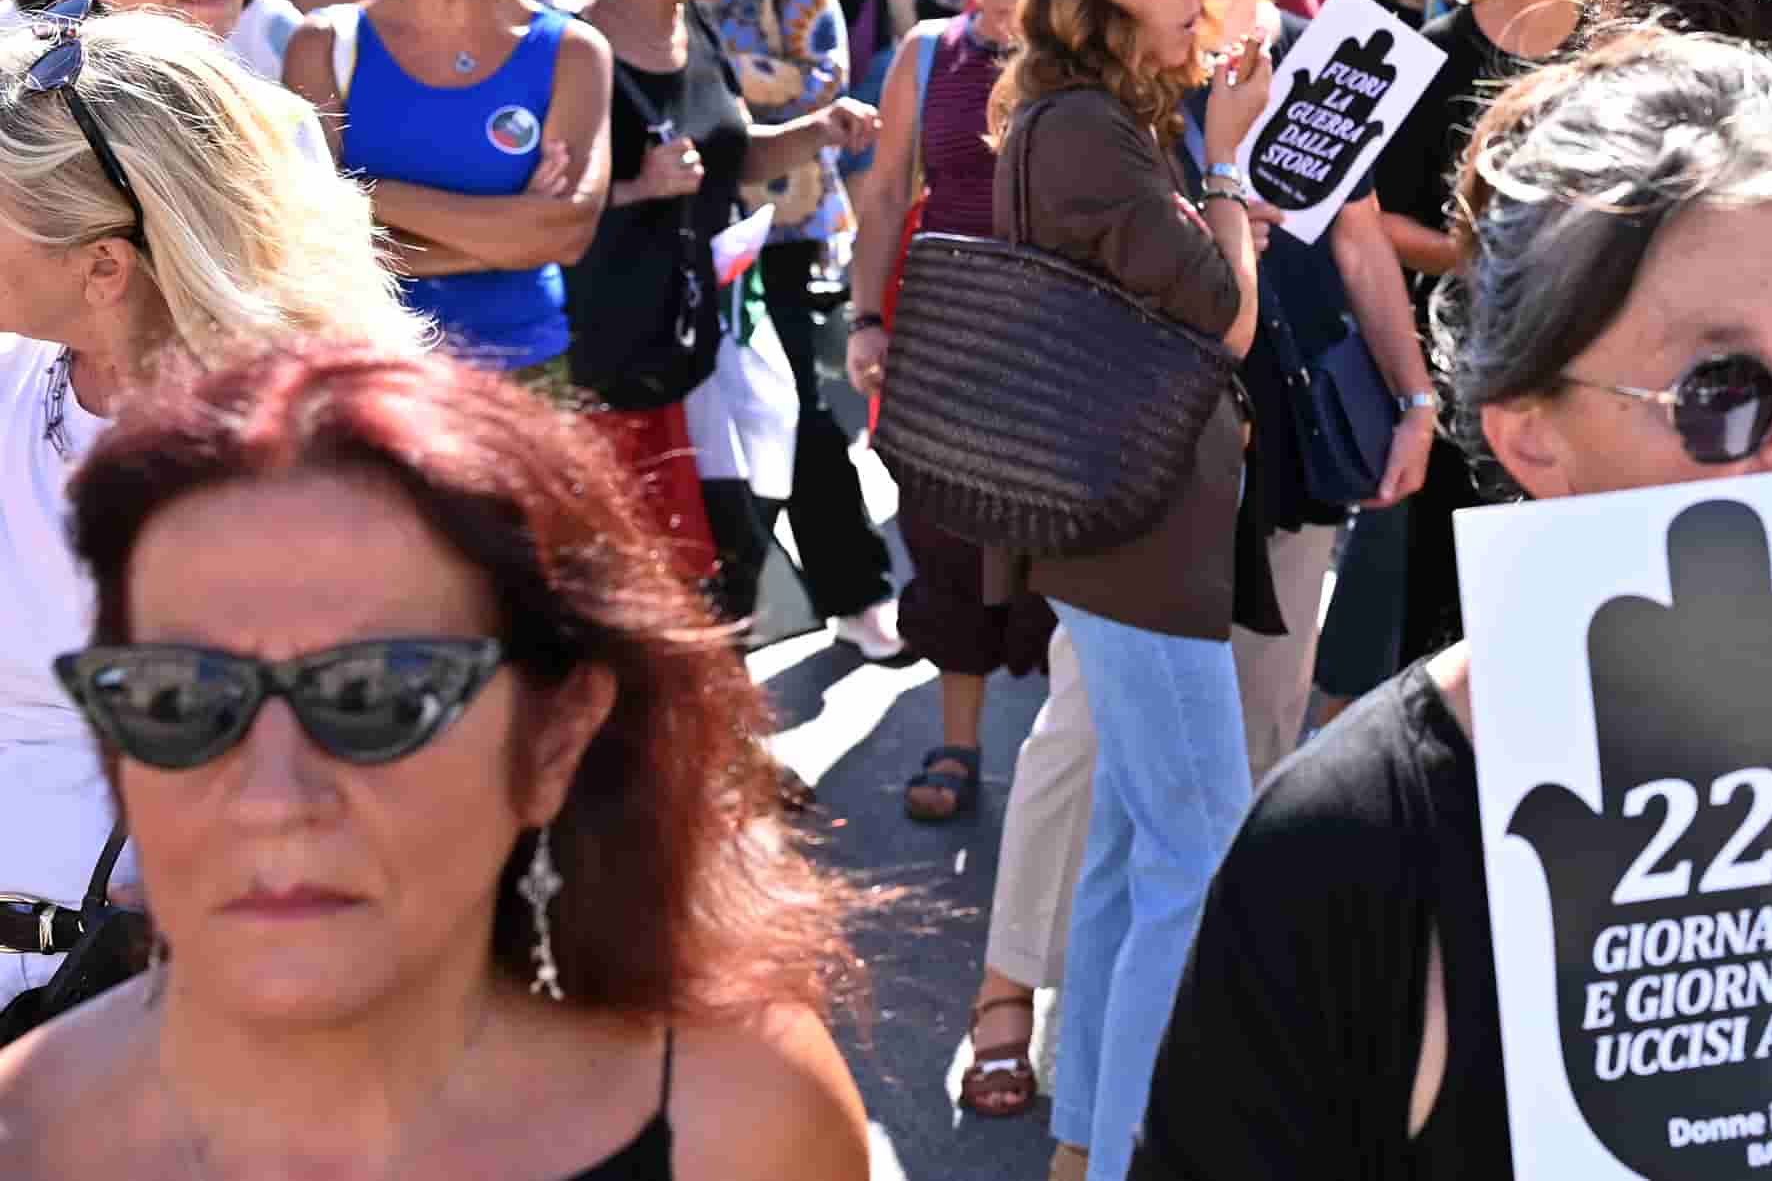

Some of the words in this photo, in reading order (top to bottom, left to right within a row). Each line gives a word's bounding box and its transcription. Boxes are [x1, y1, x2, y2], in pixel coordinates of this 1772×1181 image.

[1321, 61, 1389, 98] FUORI
[1323, 88, 1354, 111] LA
[1287, 101, 1366, 143] GUERRA
[1277, 123, 1344, 160] DALLA
[1261, 144, 1332, 182] STORIA
[1583, 982, 1617, 1029] E
[1596, 1017, 1749, 1080] UCCISI
[1669, 1110, 1766, 1148] Donne
